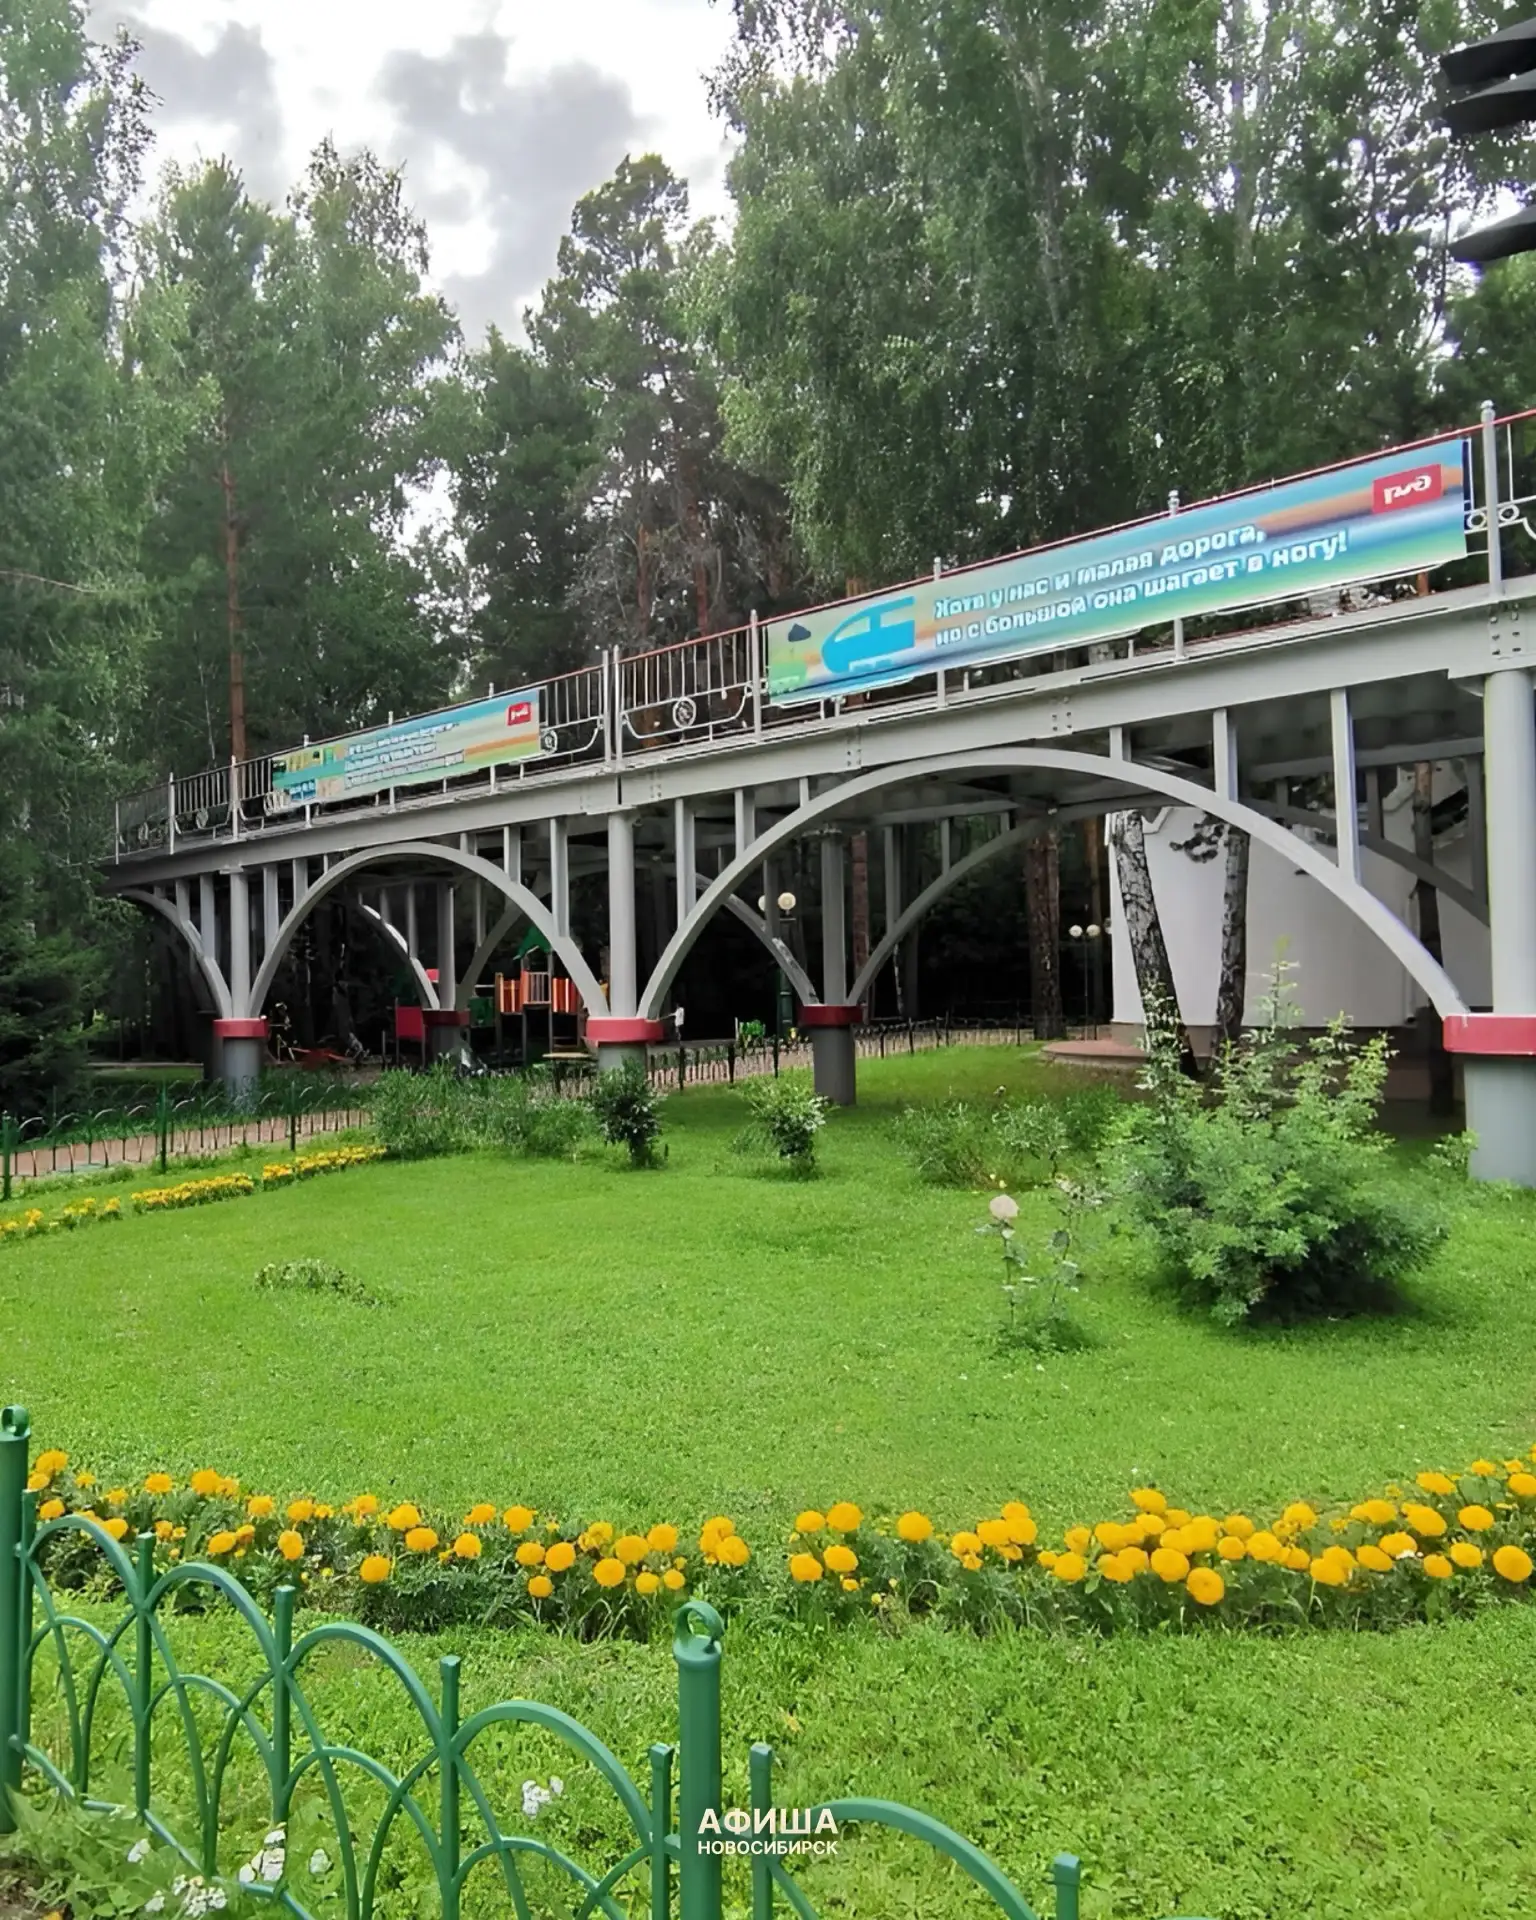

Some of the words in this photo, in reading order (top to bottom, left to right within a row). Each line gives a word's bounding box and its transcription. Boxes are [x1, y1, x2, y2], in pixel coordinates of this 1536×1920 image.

[936, 627, 962, 646] но
[967, 622, 981, 640] с
[985, 596, 1087, 635] большой
[1093, 585, 1138, 611] она
[1143, 560, 1240, 598] шагает
[1247, 554, 1265, 574] в
[1271, 529, 1348, 569] ногу!
[991, 589, 1004, 610] у
[1008, 579, 1050, 602] нас
[1055, 572, 1071, 592] и
[1076, 550, 1154, 587] малая
[1160, 524, 1266, 567] дорога,
